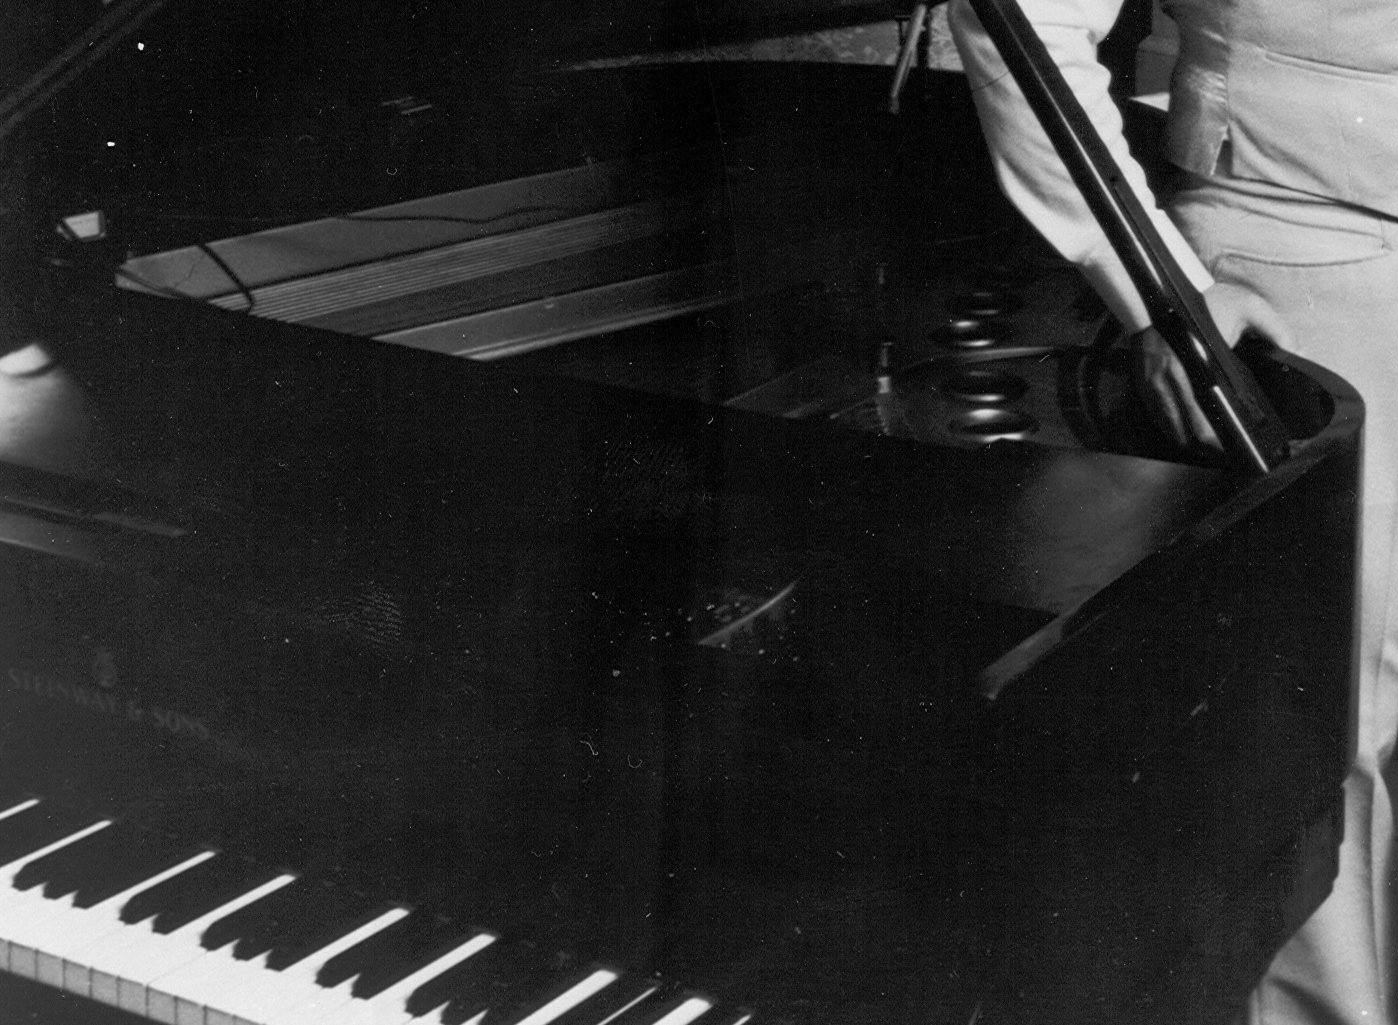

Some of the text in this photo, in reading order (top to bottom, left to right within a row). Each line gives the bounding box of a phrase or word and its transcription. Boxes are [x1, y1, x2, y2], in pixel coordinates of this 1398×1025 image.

[8, 667, 210, 741] STEINWAY & SONS
